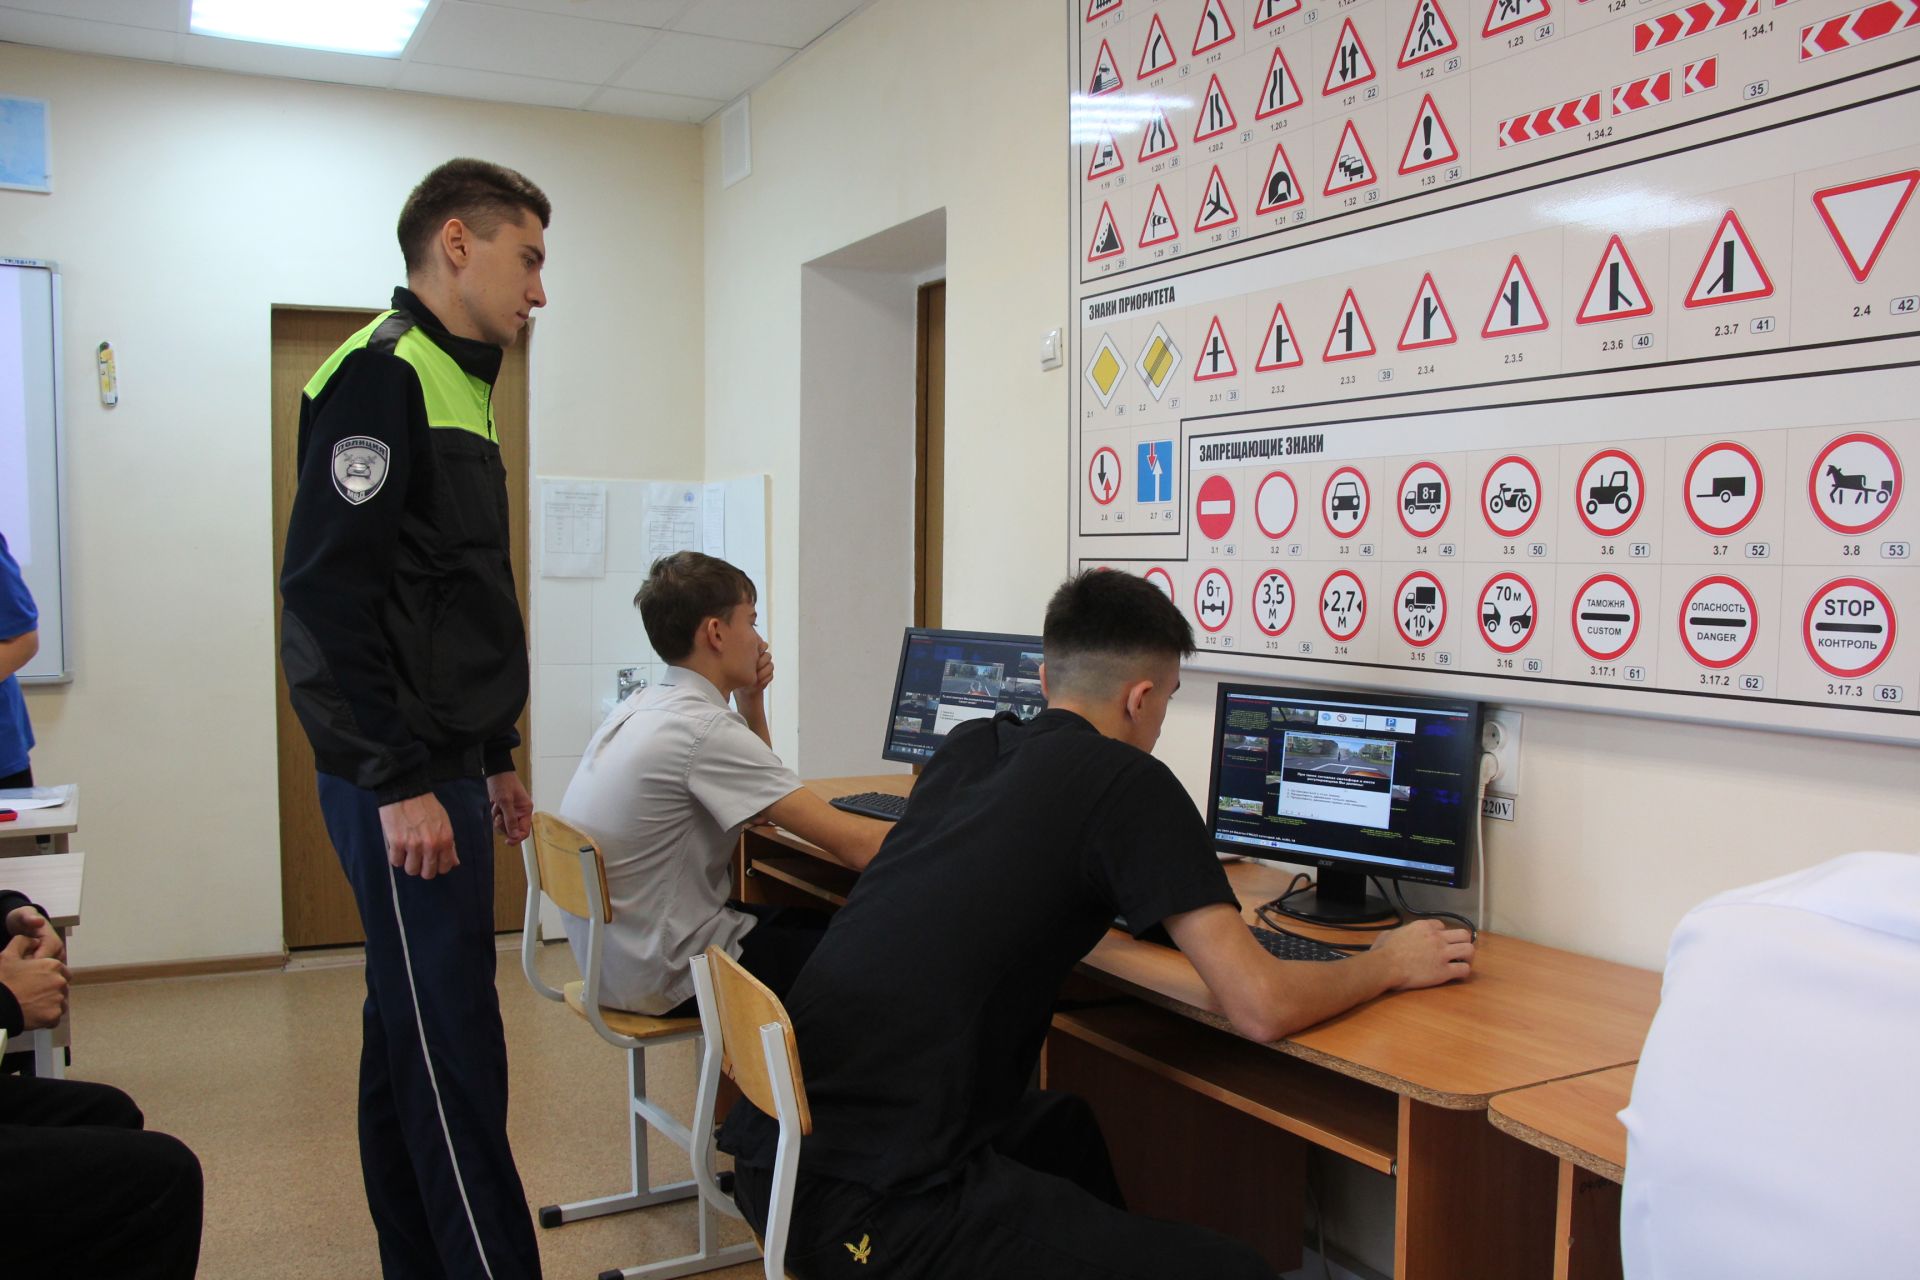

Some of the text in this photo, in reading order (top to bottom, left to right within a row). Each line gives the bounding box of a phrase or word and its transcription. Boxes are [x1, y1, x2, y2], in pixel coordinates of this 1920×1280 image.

[1269, 12, 1316, 37] 1.12.1 13
[1742, 20, 1774, 41] 1.34.1
[1507, 26, 1551, 48] 1.23 24
[1181, 66, 1189, 75] 12
[1420, 61, 1458, 79] 1.22 23
[1343, 88, 1376, 106] 1.21 22
[1750, 83, 1764, 97] 35
[1270, 119, 1288, 132] 1.20.3
[1586, 126, 1613, 142] 1.34.2
[1421, 168, 1459, 186] 1.33 34
[1344, 191, 1377, 207] 1.32 33
[1275, 211, 1304, 225] 1.31 32
[1089, 286, 1175, 320] ЗНАКИ ПРИОРИТЕТА
[1853, 299, 1914, 318] 2.4 42
[1714, 319, 1770, 337] 2.3.7 41
[1602, 335, 1649, 351] 2.3.6 40
[1504, 353, 1523, 364] 2.3.5
[1417, 365, 1435, 376] 2.3.4
[1340, 371, 1391, 385] 2.3.3 39
[1271, 384, 1286, 395] 2.3.2
[337, 440, 386, 455] ПОЛИЦИЯ
[1199, 434, 1324, 462] ЗАПРЕЩАЮЩИЕ ЗНАКИ
[1270, 546, 1299, 554] 3.2 47
[1340, 545, 1371, 554] 3.3 48
[1416, 545, 1453, 555] 3.4 49
[1503, 545, 1543, 555] 3.5 50
[1601, 545, 1646, 556] 3.6 51
[1713, 545, 1765, 556] 3.7 52
[1843, 545, 1904, 556] 3.8 53
[1262, 583, 1285, 607] 3,5
[1331, 590, 1356, 615] 2,7
[1587, 598, 1625, 609] ТАМОЖНЯ
[1691, 601, 1746, 613] ОПАСНОСТЬ
[1824, 599, 1876, 617] STOP
[1412, 615, 1426, 629] 10
[1587, 626, 1622, 636] CUSTOM
[1697, 632, 1737, 643] DANGER
[1334, 646, 1348, 655] 3.14
[1818, 638, 1878, 650] КОНТРОЛЬ
[1410, 652, 1449, 663] 3.15 59
[1497, 659, 1539, 670] 3.16 60
[1590, 666, 1641, 679] 3.17.1 61
[1700, 675, 1759, 689] 3.17.2 62
[1827, 684, 1897, 700] 3.17.3 63
[1482, 799, 1511, 816] 220V
